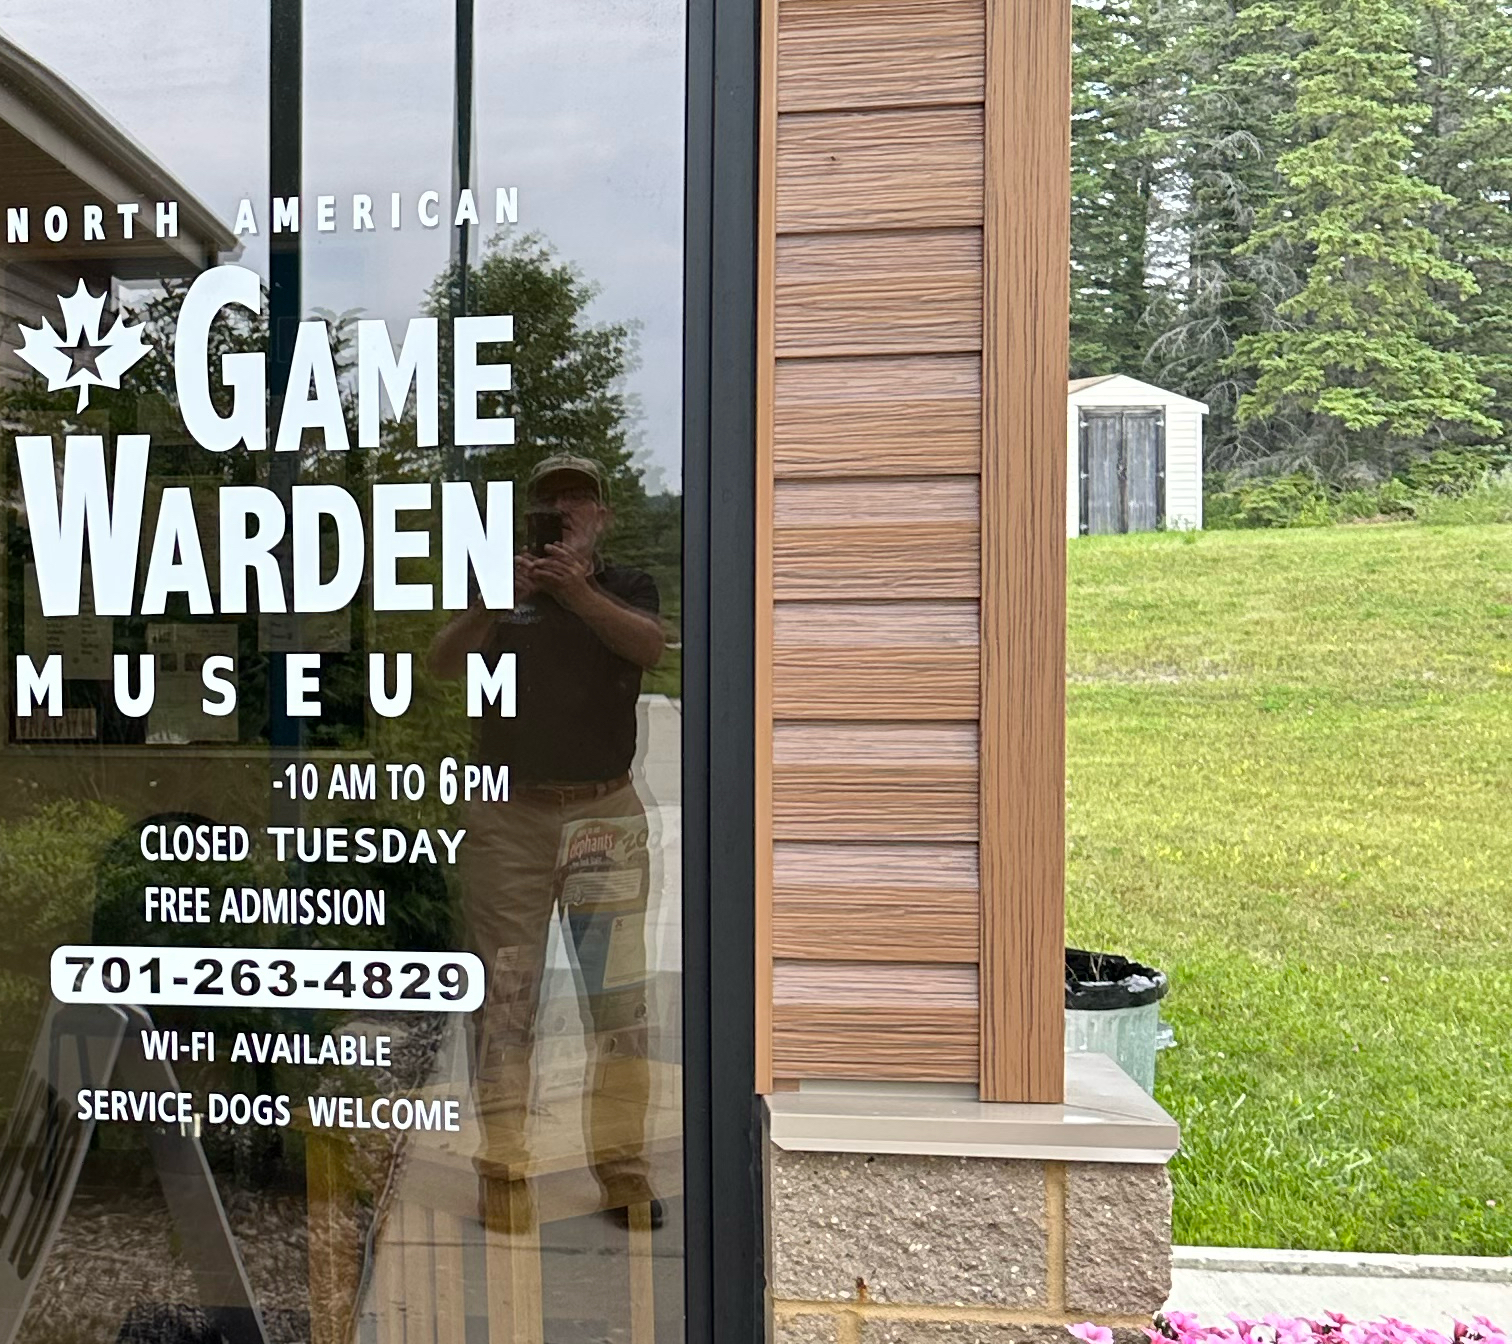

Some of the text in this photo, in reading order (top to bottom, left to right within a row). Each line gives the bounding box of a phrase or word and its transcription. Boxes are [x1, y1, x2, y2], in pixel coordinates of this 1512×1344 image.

[6, 187, 519, 244] NORTH AMERICAN
[174, 265, 516, 452] GAME
[15, 434, 516, 617] WARDEN
[16, 652, 517, 718] MUSEUM
[327, 763, 377, 801] AM
[385, 764, 426, 801] TO
[140, 824, 467, 865] CLOSED TUESDAY
[145, 886, 387, 926] FREE ADMISSION
[65, 956, 470, 1001] 701-263-4829
[140, 1030, 393, 1067] WI-FI AVAILABLE
[76, 1089, 461, 1133] SERVICE DOGS WELCOME
